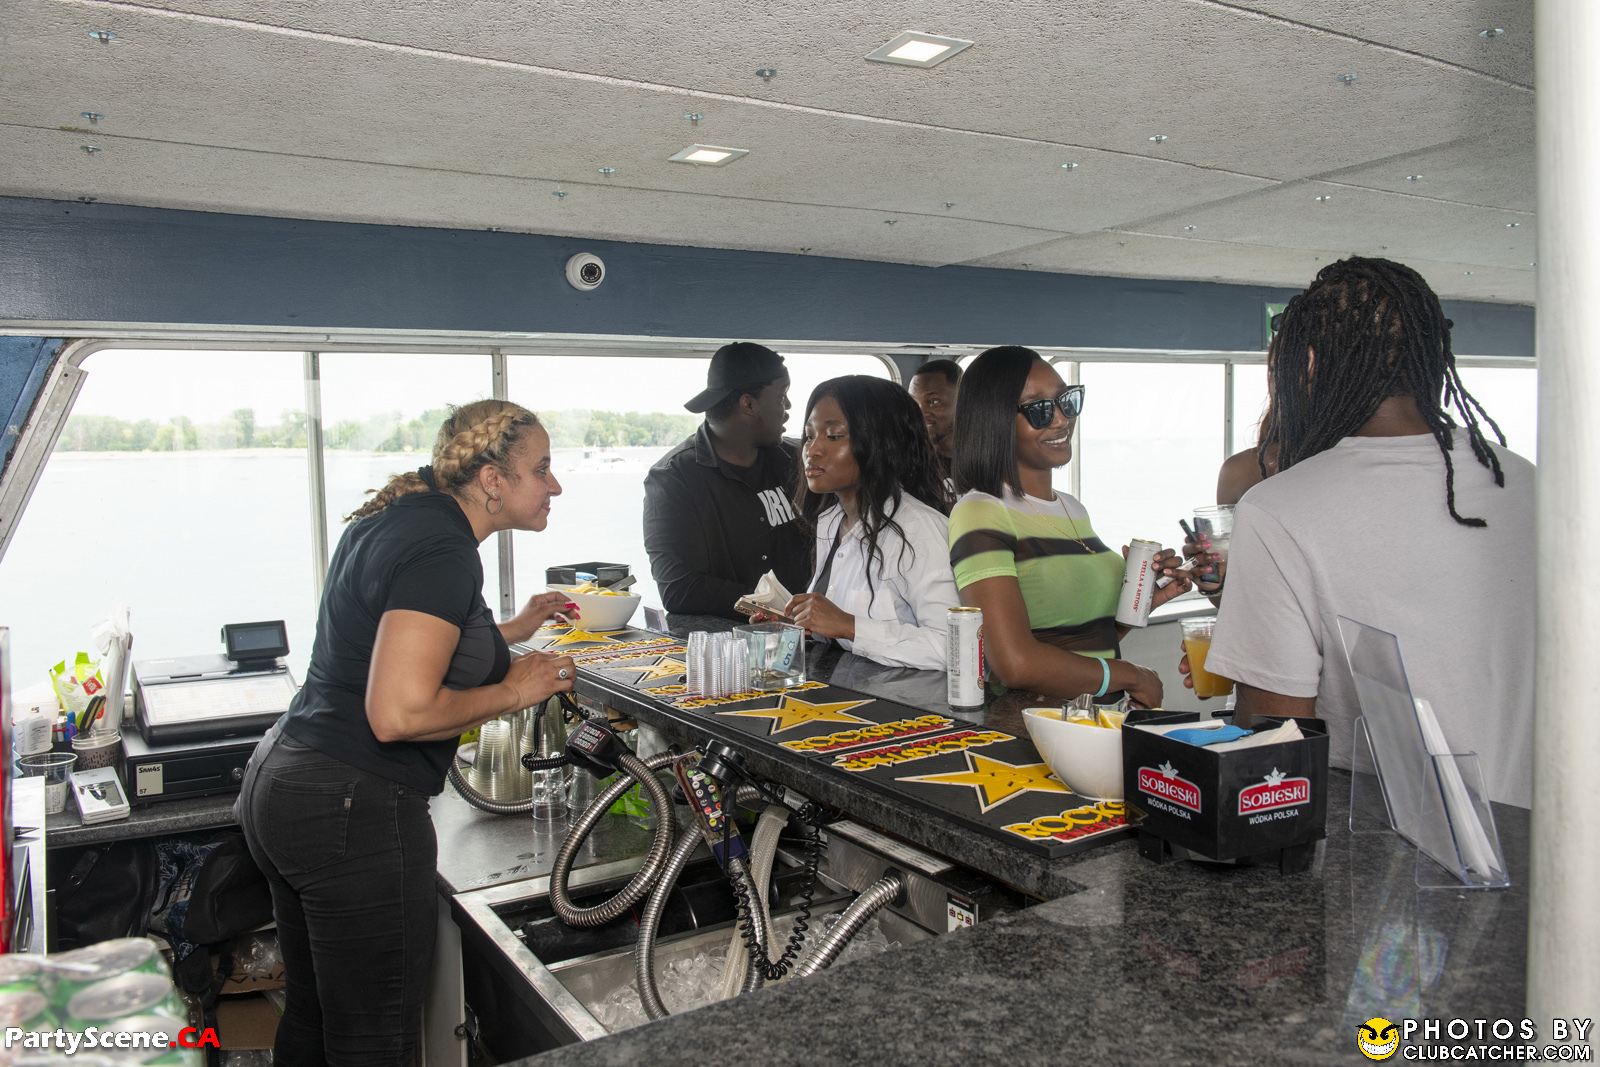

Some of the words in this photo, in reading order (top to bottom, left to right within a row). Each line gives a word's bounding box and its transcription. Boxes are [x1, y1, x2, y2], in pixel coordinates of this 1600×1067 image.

[1139, 560, 1148, 582] STELLA
[1133, 588, 1142, 611] ARTOIS
[1141, 774, 1197, 806] SOBIESKI
[1242, 785, 1306, 809] SOBIESKI
[1168, 805, 1192, 821] POLSKA
[1248, 813, 1273, 825] WÓDKA
[1273, 808, 1299, 820] POLSKA
